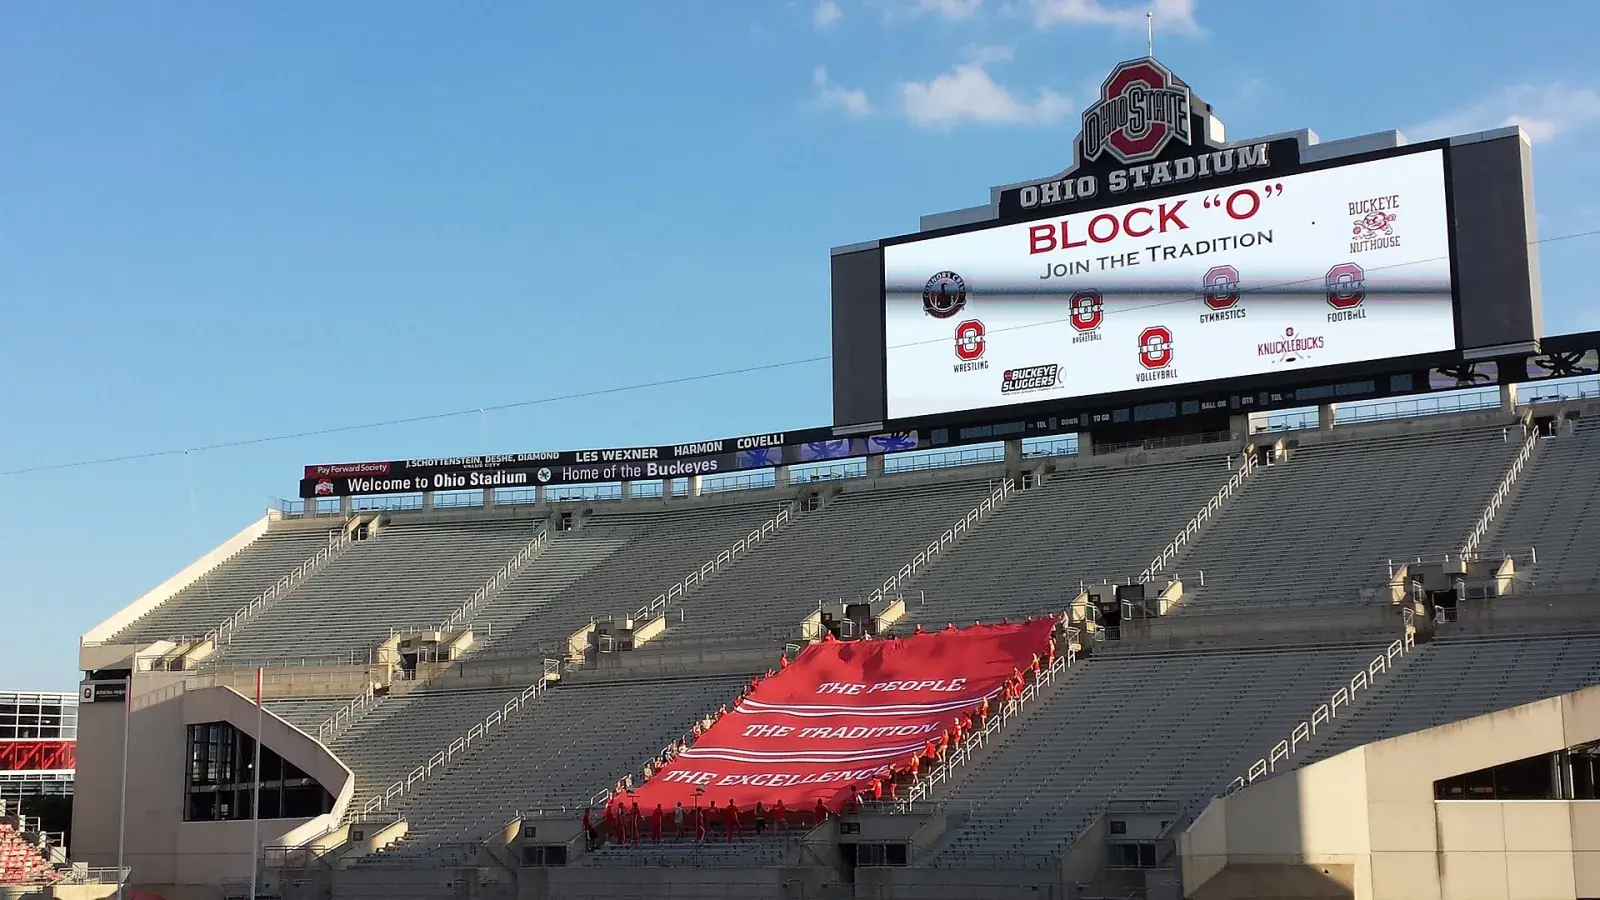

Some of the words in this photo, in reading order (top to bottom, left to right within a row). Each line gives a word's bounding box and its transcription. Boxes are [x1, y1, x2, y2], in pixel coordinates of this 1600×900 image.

[1084, 95, 1126, 157] OHIO
[1127, 86, 1189, 138] STATE
[1020, 176, 1099, 209] OHIO
[1109, 143, 1270, 192] STADIUM
[1348, 195, 1400, 215] BUCKEYE
[1028, 200, 1190, 255] BLOCK
[1350, 236, 1401, 253] NUTHOUSE
[1200, 308, 1246, 324] GYMNASTICS
[1327, 308, 1367, 323] FOOTBALL
[1072, 334, 1102, 344] BASKETBALL
[1258, 336, 1325, 356] KNUCKLEBUCKS
[953, 361, 989, 373] WRESTLING
[1012, 364, 1058, 379] BUCKEYE
[1136, 369, 1178, 382] VOLLEYBALL
[1002, 376, 1055, 392] SLUGGERS
[1201, 401, 1216, 410] BALL
[1093, 414, 1100, 422] TO
[674, 441, 723, 456] HARMON
[737, 434, 784, 449] COVELLI
[485, 454, 516, 464] DESHE,
[518, 452, 560, 462] DIAMOND
[576, 451, 598, 463] LES
[602, 449, 658, 462] WEXNER
[318, 466, 331, 476] Pay
[331, 464, 360, 473] Forward
[360, 464, 388, 472] Society
[562, 466, 600, 481] Home
[603, 465, 618, 478] of
[620, 464, 641, 478] the
[646, 458, 718, 476] Buckeyes
[348, 477, 411, 492] Welcome
[415, 476, 428, 488] to
[434, 472, 466, 488] Ohio
[470, 470, 526, 486] Stadium
[816, 682, 866, 695] THE
[867, 677, 967, 694] PEOPLE.
[742, 724, 796, 738] THE
[662, 770, 717, 786] THE
